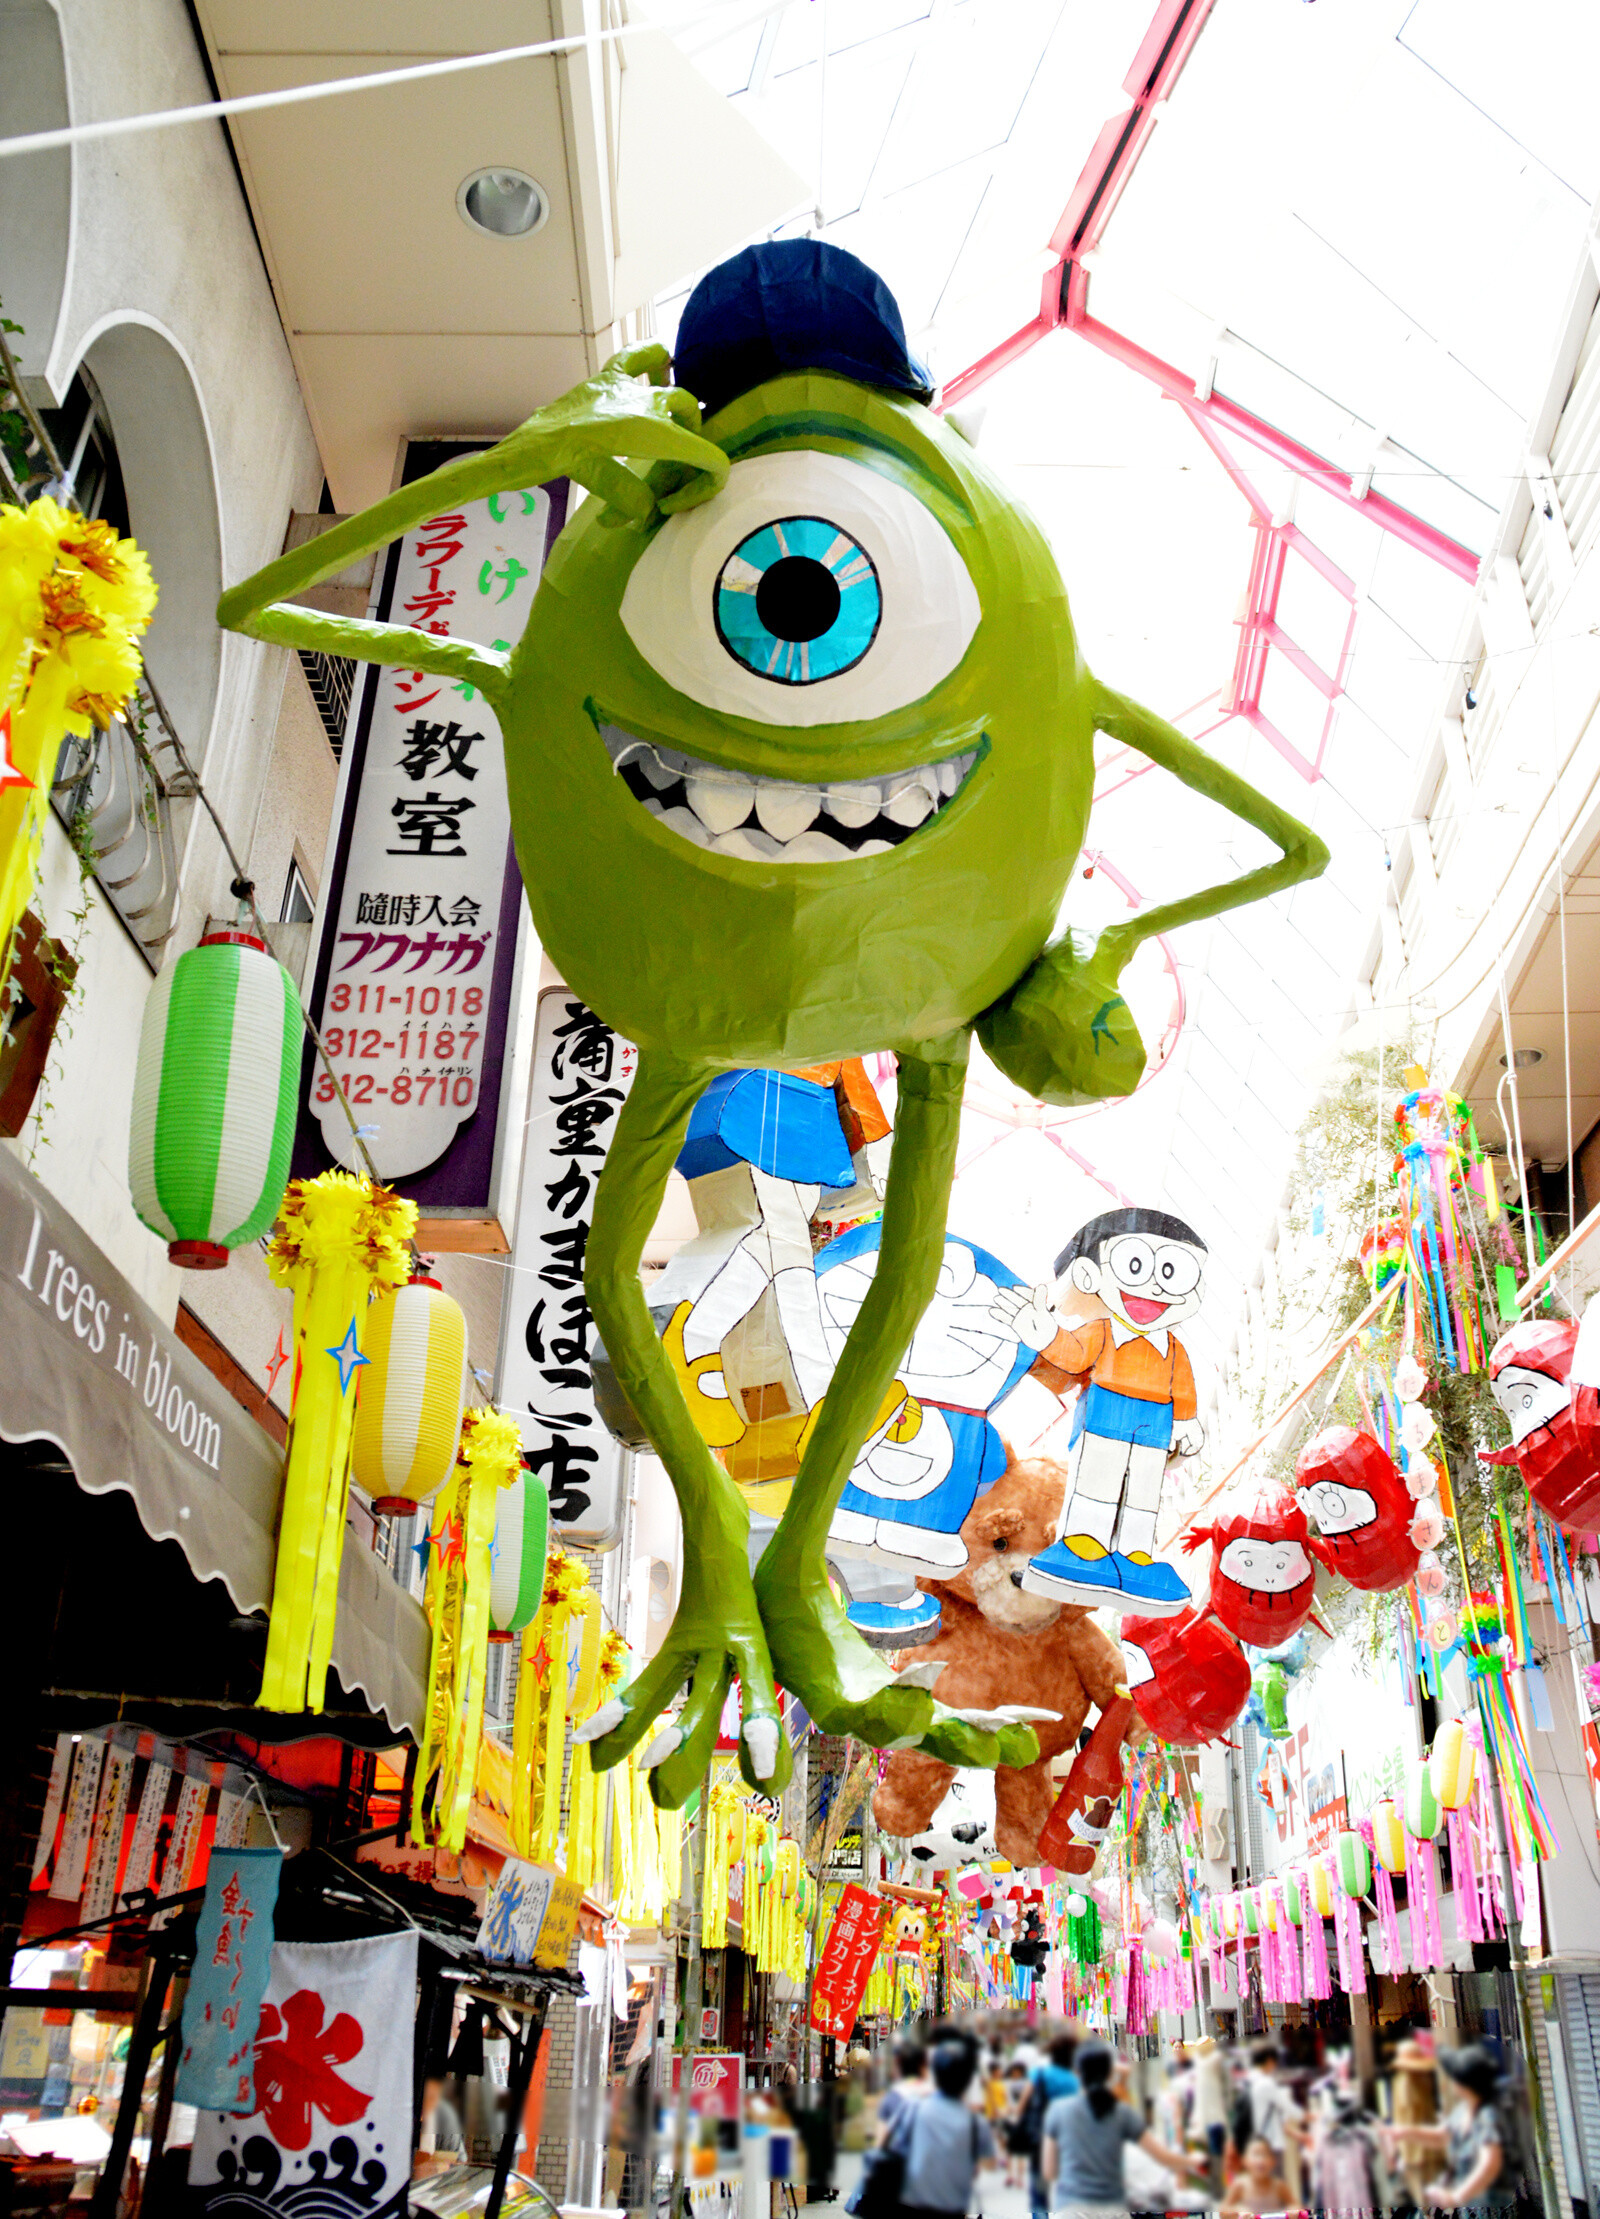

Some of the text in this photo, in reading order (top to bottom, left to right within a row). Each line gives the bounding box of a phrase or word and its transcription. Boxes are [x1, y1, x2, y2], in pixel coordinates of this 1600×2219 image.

[386, 720, 486, 858] 教室
[336, 931, 493, 976] フクナガ
[330, 983, 484, 1016] 311-1018
[324, 1027, 480, 1061] 312-1187
[315, 1072, 474, 1107] 312-8710
[114, 1312, 140, 1389] in
[143, 1333, 222, 1471] bloom
[821, 1898, 864, 1988] 漫画カフェ
